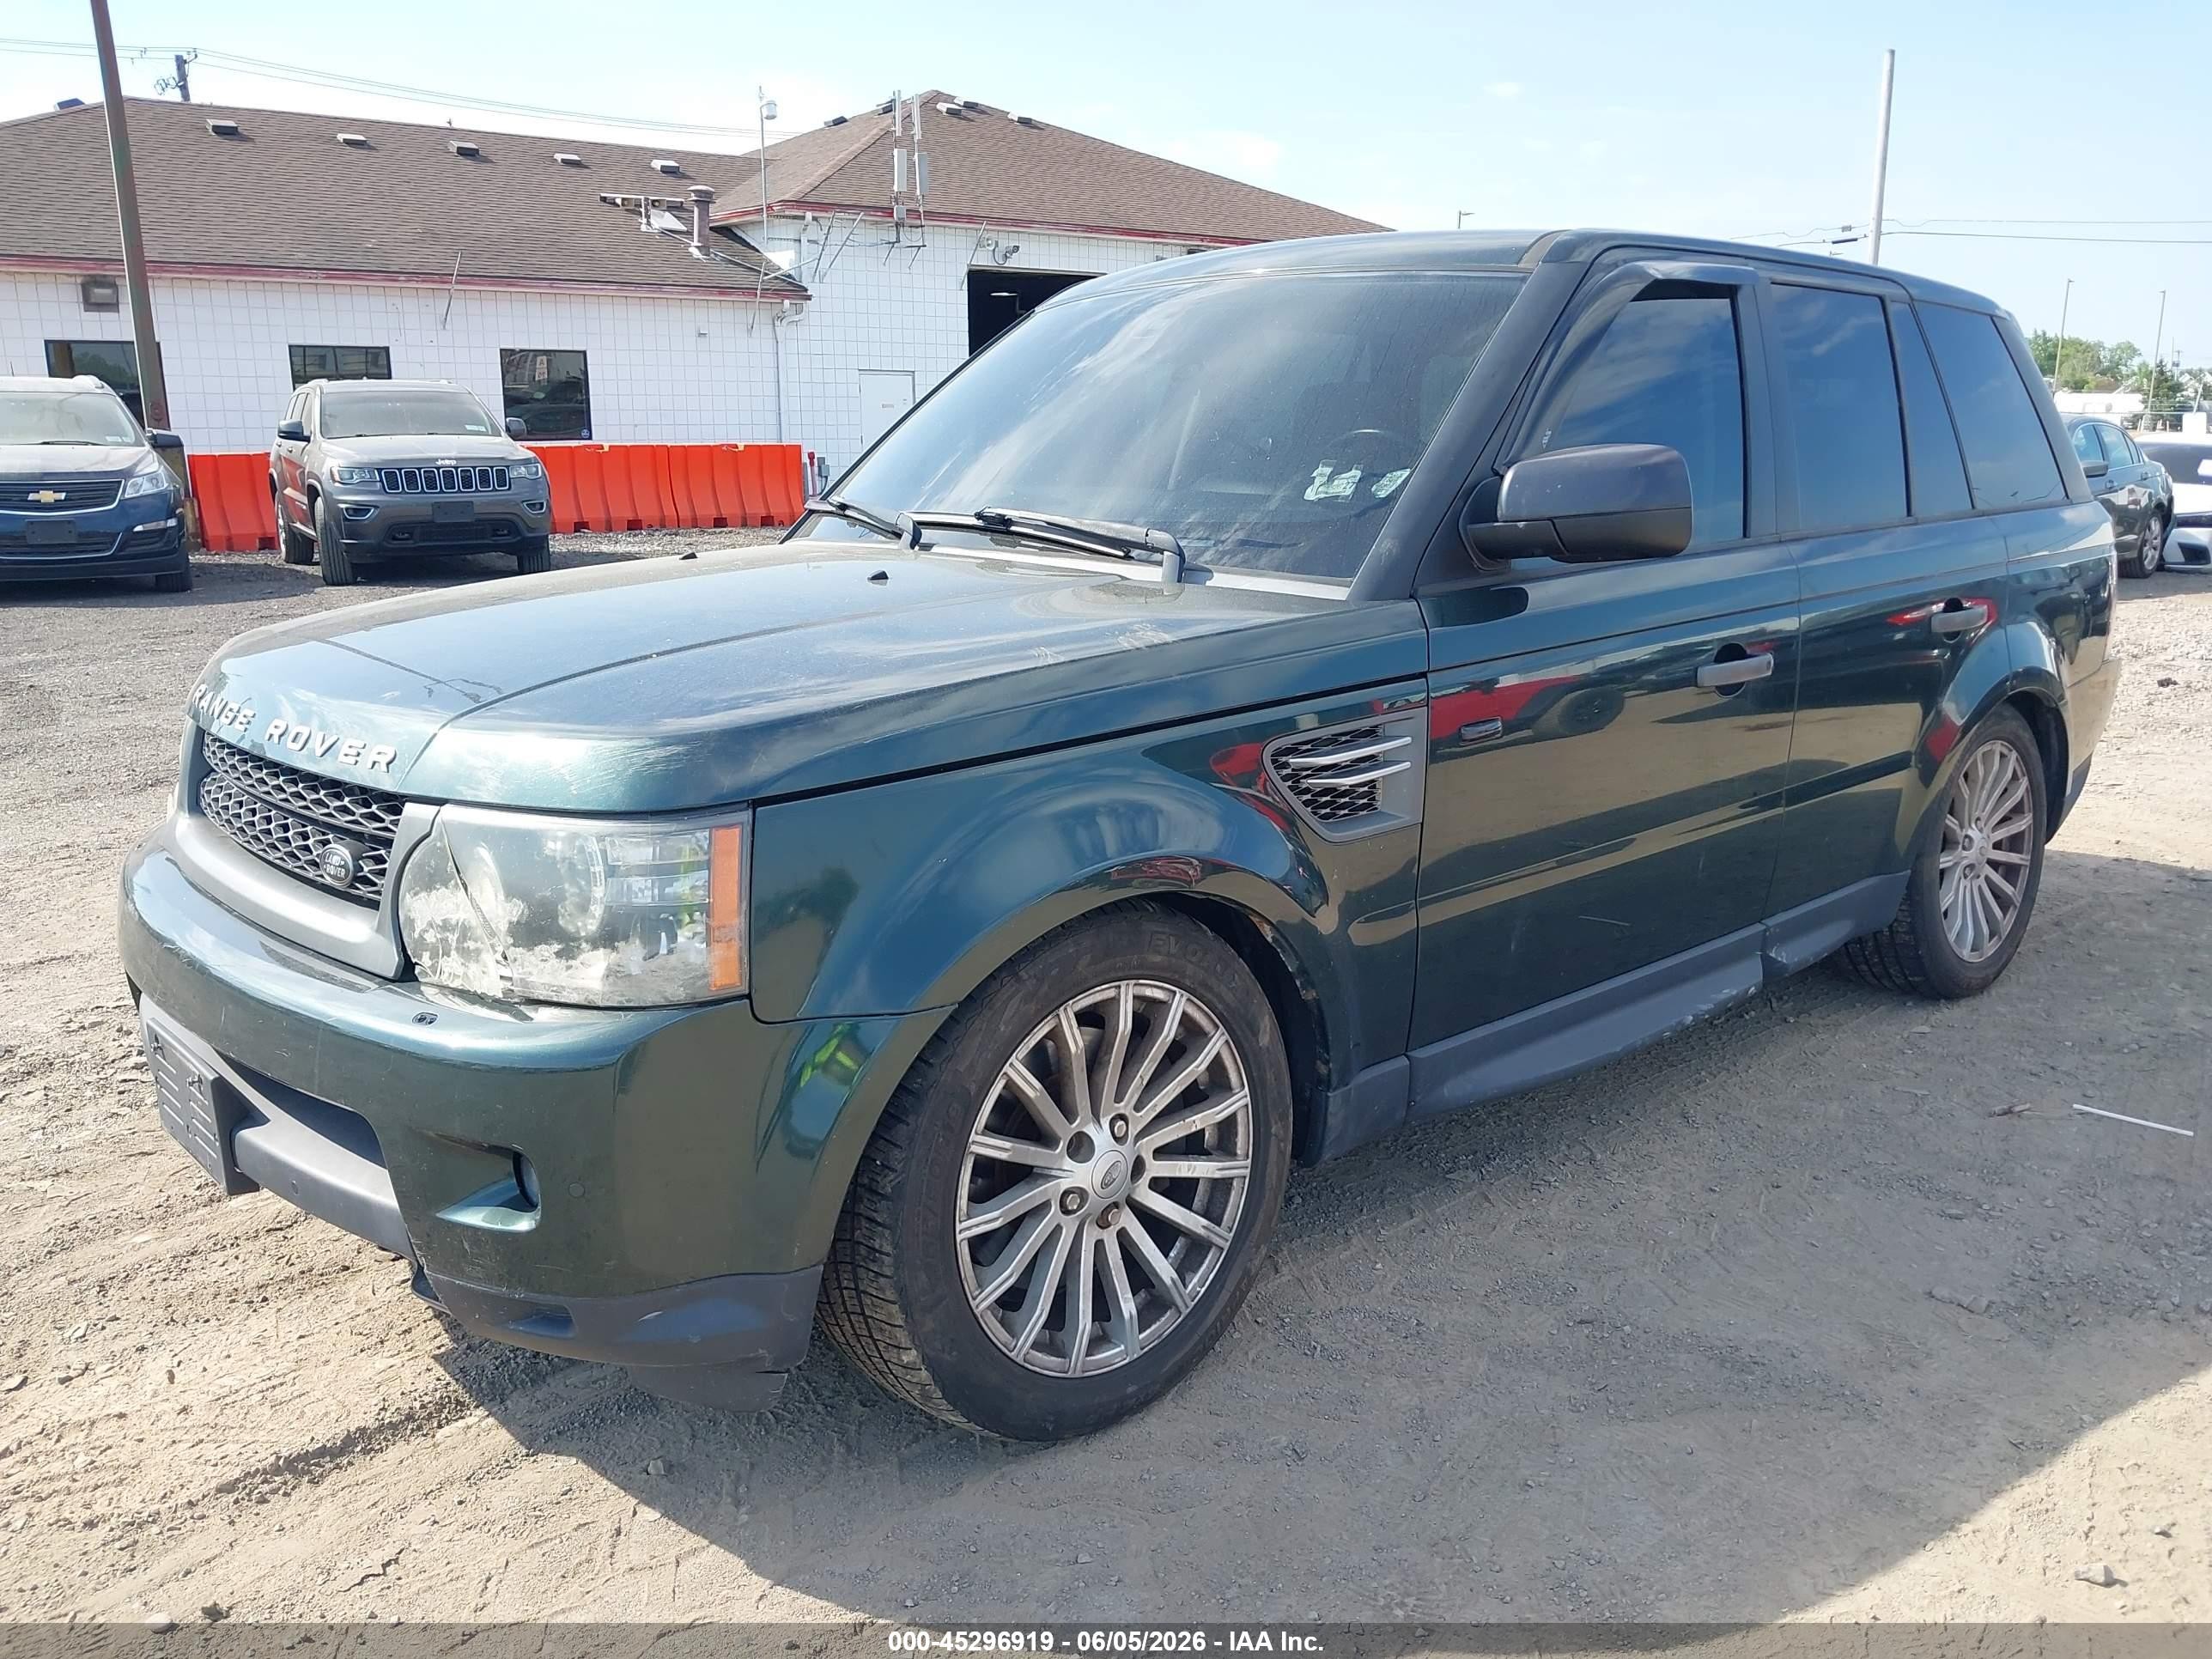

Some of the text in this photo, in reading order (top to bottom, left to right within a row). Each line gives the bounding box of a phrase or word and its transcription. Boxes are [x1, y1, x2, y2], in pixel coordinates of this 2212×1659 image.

[191, 683, 398, 774] RANGE ROVER
[325, 852, 342, 866] LAND
[325, 864, 346, 878] ROVER
